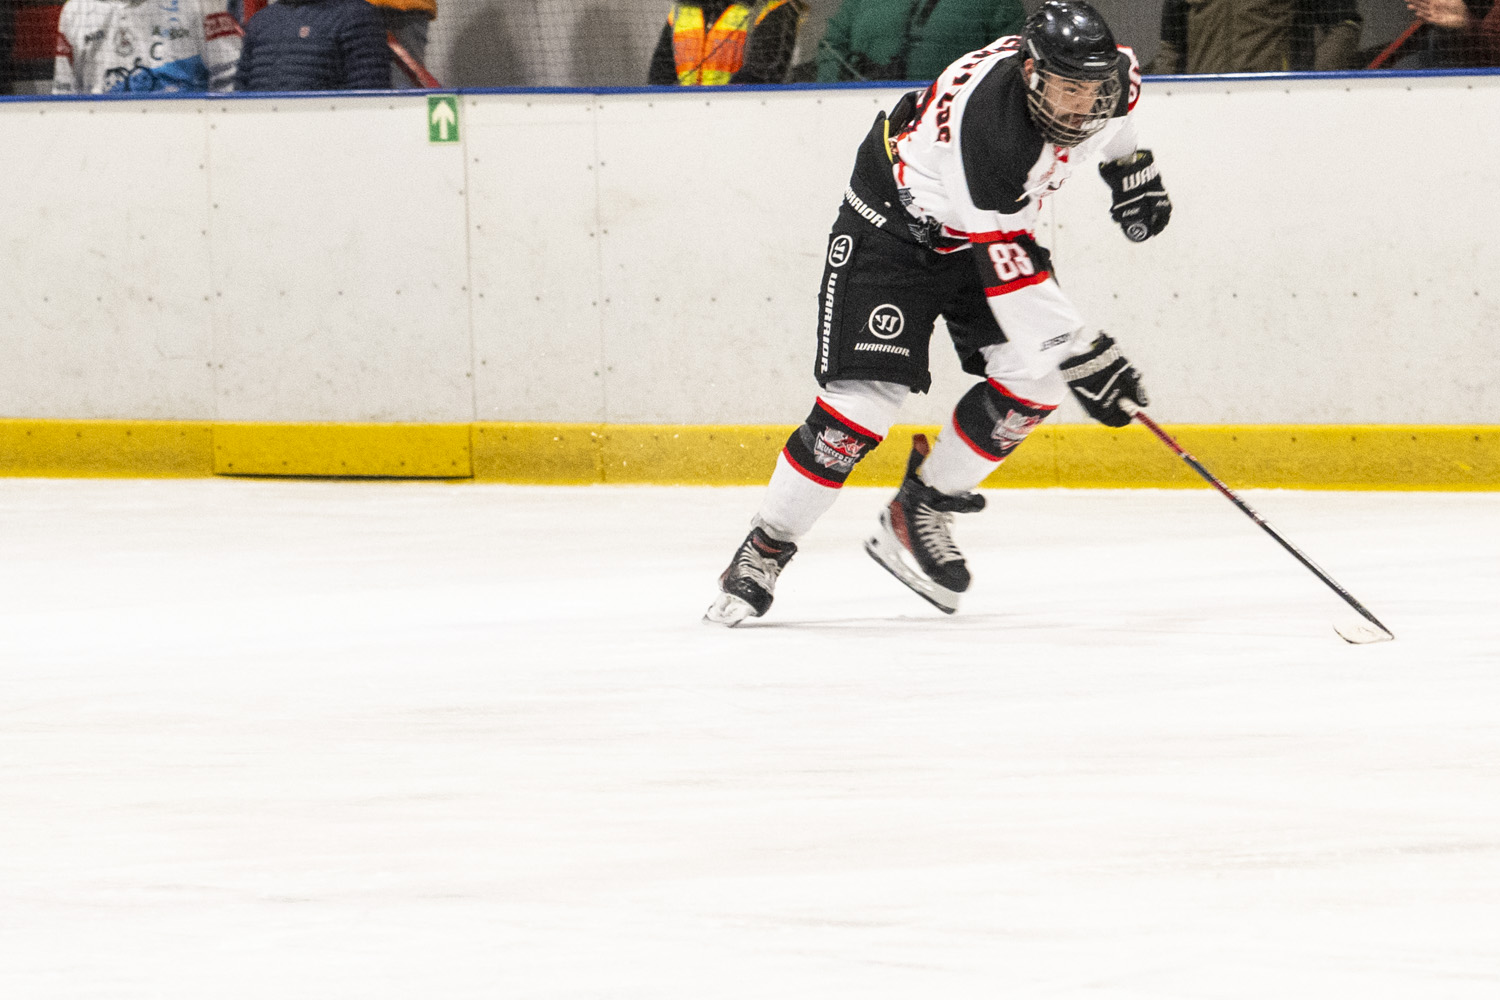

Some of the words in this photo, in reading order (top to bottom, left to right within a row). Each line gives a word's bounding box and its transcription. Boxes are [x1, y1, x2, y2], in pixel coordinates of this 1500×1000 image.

[988, 242, 1035, 282] 83
[821, 272, 838, 374] WARRIOR
[854, 342, 910, 357] WARRIOR
